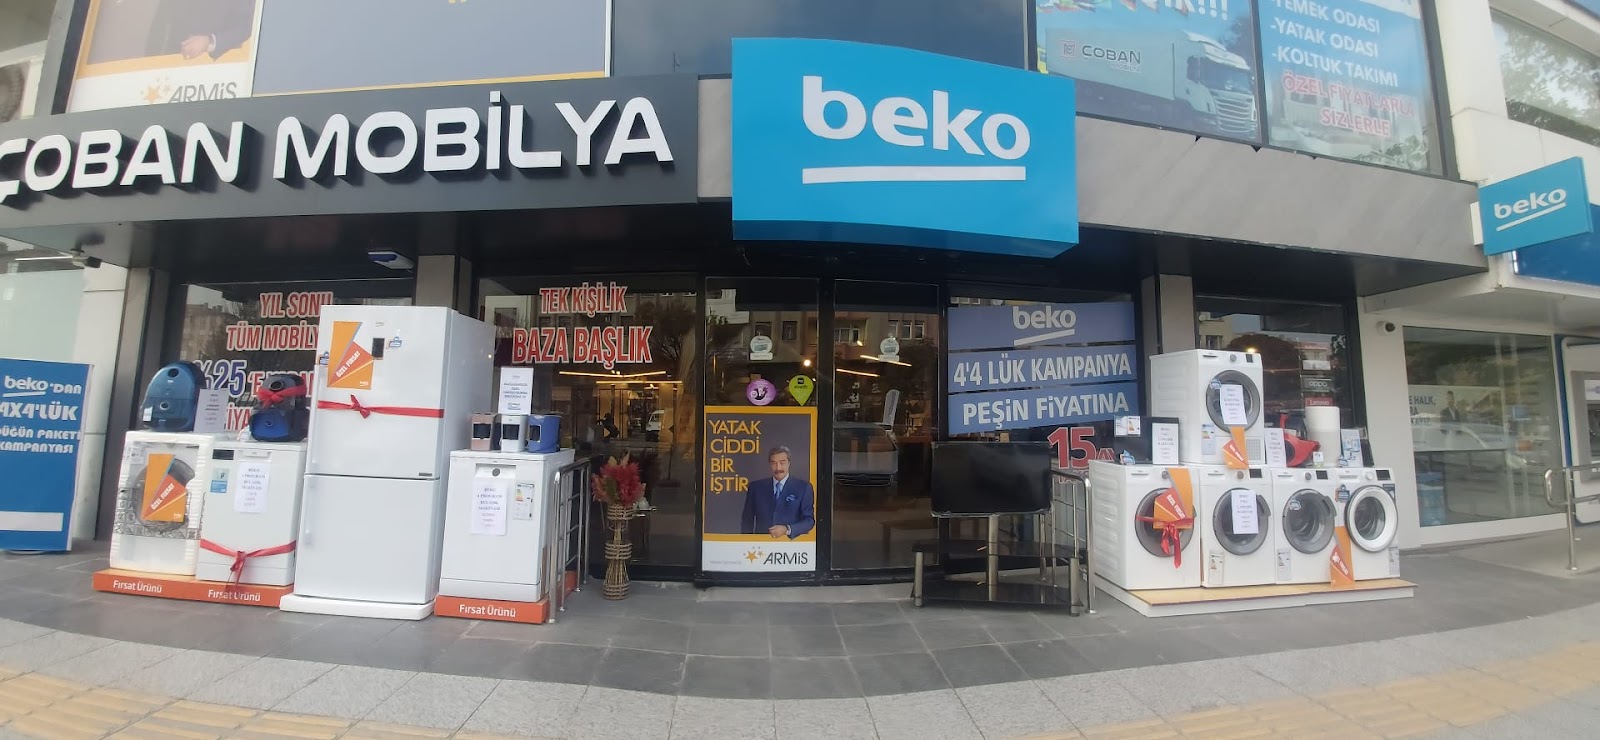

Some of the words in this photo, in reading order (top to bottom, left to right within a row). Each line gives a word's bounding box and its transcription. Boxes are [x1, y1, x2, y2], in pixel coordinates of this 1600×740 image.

[1333, 8, 1381, 34] ODASI
[1329, 33, 1379, 58] ODASI
[1344, 61, 1399, 87] TAKIMI
[1281, 68, 1328, 98] ÖZEL
[1328, 80, 1415, 117] FİYATLARLA
[802, 75, 1031, 160] beko
[1320, 107, 1391, 137] SİZLERLE
[272, 90, 674, 180] MOBİLYA
[1494, 188, 1567, 219] beko
[260, 292, 285, 318] YIL
[540, 287, 570, 314] TEK
[572, 281, 628, 318] KİŞİLİK
[1012, 305, 1077, 329] beko
[226, 321, 262, 351] TÜM
[512, 327, 569, 364] BAZA
[573, 326, 653, 370] BAŞLIK
[953, 360, 982, 386] 4'4
[988, 353, 1026, 385] LÜK
[1031, 352, 1132, 382] KAMPANYA
[0, 425, 34, 439] ÜĞÜN
[708, 419, 762, 435] YATAK
[710, 436, 760, 454] CİDDİ
[1047, 427, 1097, 469] 15
[711, 455, 734, 473] BİR
[710, 474, 749, 495] İŞTİR
[113, 580, 136, 591] Fırsat
[137, 580, 162, 593] Ürünü
[208, 589, 232, 600] Fırsat
[459, 604, 485, 615] Fırsat
[487, 605, 516, 618] Ürünü
